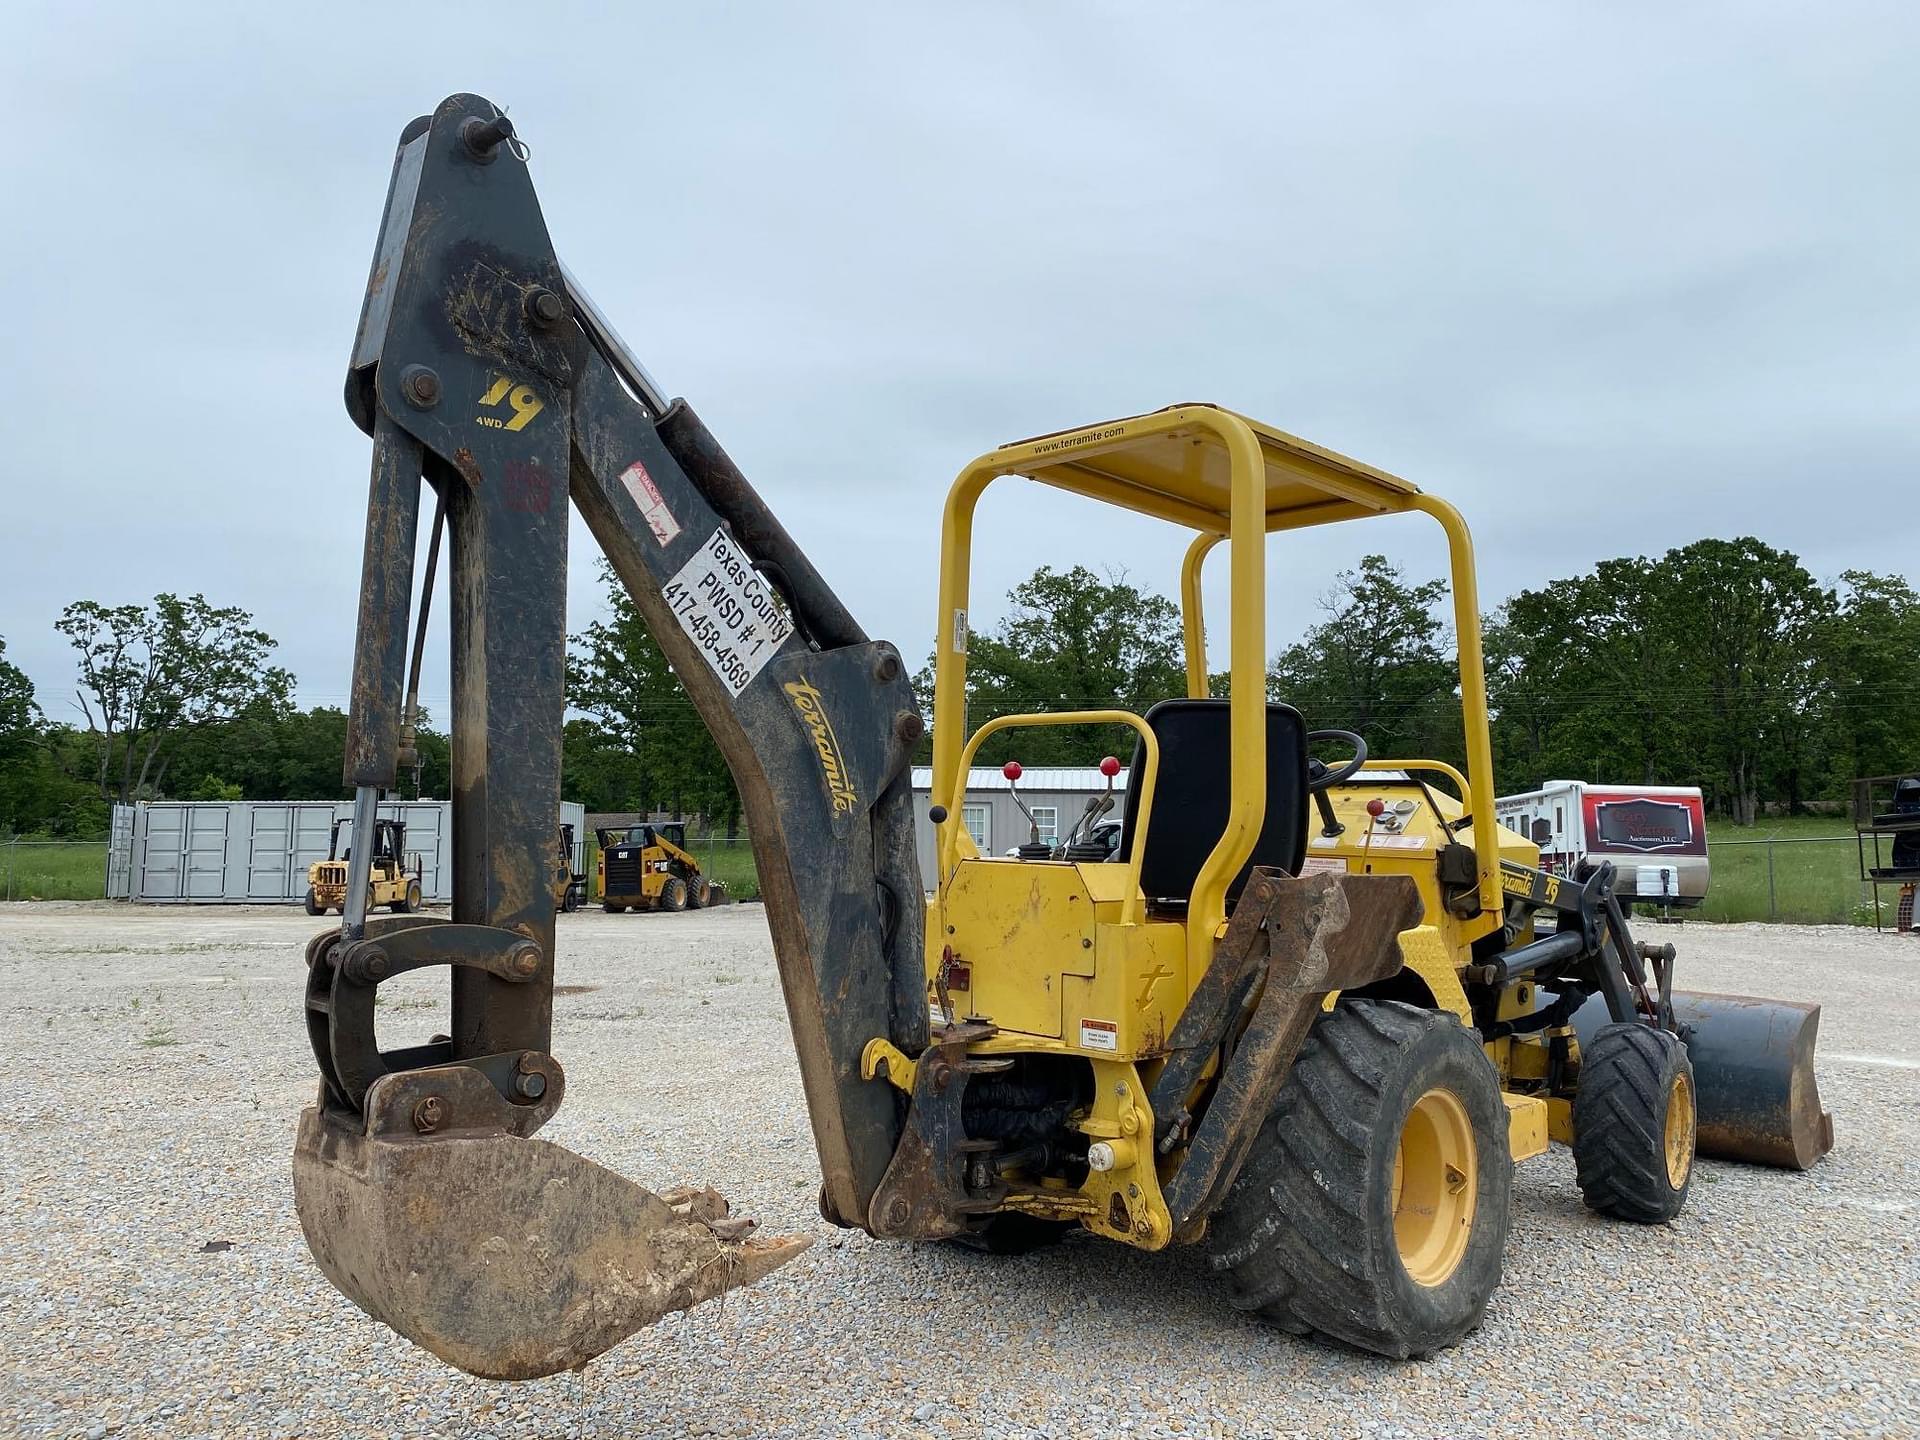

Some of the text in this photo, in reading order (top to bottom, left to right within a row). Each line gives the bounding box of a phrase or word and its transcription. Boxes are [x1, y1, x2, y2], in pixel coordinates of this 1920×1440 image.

[476, 416, 503, 429] 4WD
[1034, 426, 1125, 454] www.terramite.com
[698, 571, 765, 657] PWSD # 1
[709, 530, 789, 644] Texas County
[665, 583, 750, 690] 417-458-4569
[784, 675, 858, 813] terramite
[618, 851, 629, 859] CAT
[1544, 877, 1561, 905] T9
